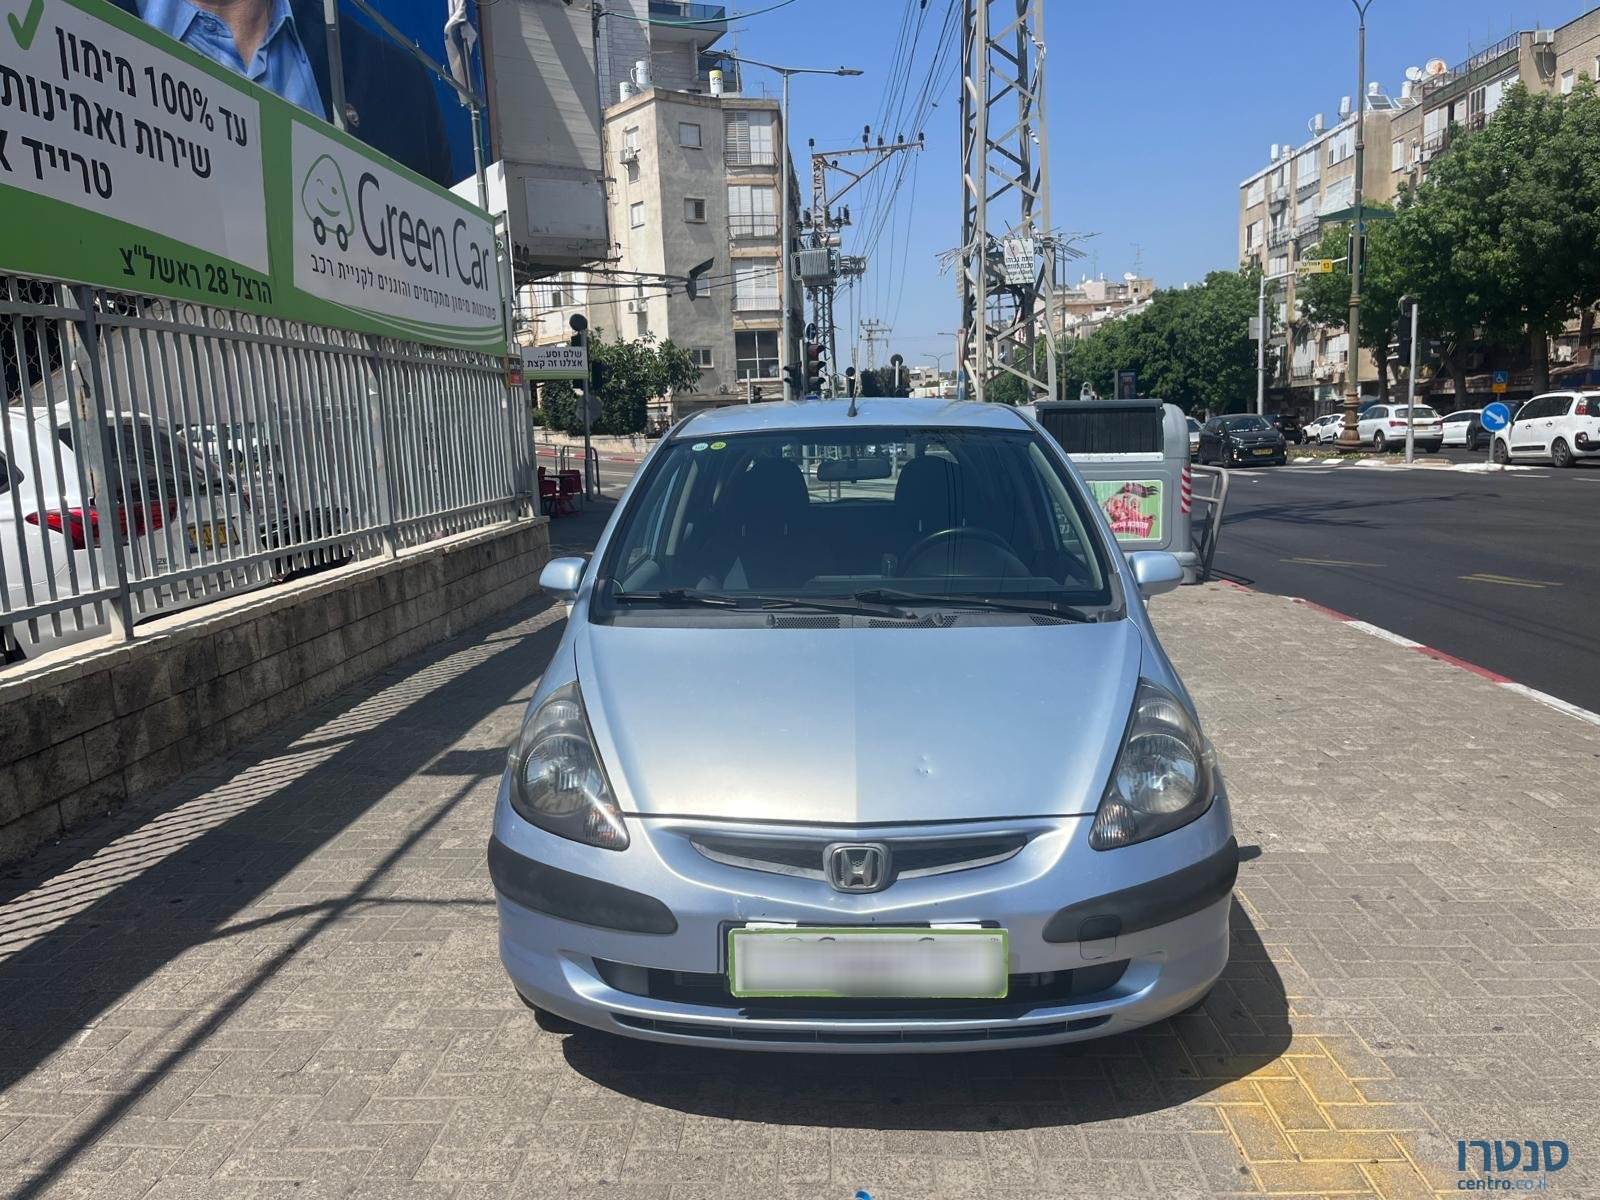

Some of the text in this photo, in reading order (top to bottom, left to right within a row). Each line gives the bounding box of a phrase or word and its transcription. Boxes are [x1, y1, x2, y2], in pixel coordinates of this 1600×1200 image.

[55, 25, 248, 147] עד 100% מימון
[0, 64, 212, 179] שירות ואמינות
[21, 135, 113, 200] טרייד
[310, 253, 334, 276] רכב
[337, 262, 374, 290] לקניית
[205, 263, 229, 295] 28
[231, 268, 273, 304] הרצל
[377, 273, 411, 298] והוגנים
[413, 284, 450, 309] מתקדמים
[527, 360, 546, 370] קצת
[547, 360, 557, 368] זה
[560, 359, 583, 368] אצלנו
[563, 349, 582, 358] שלם
